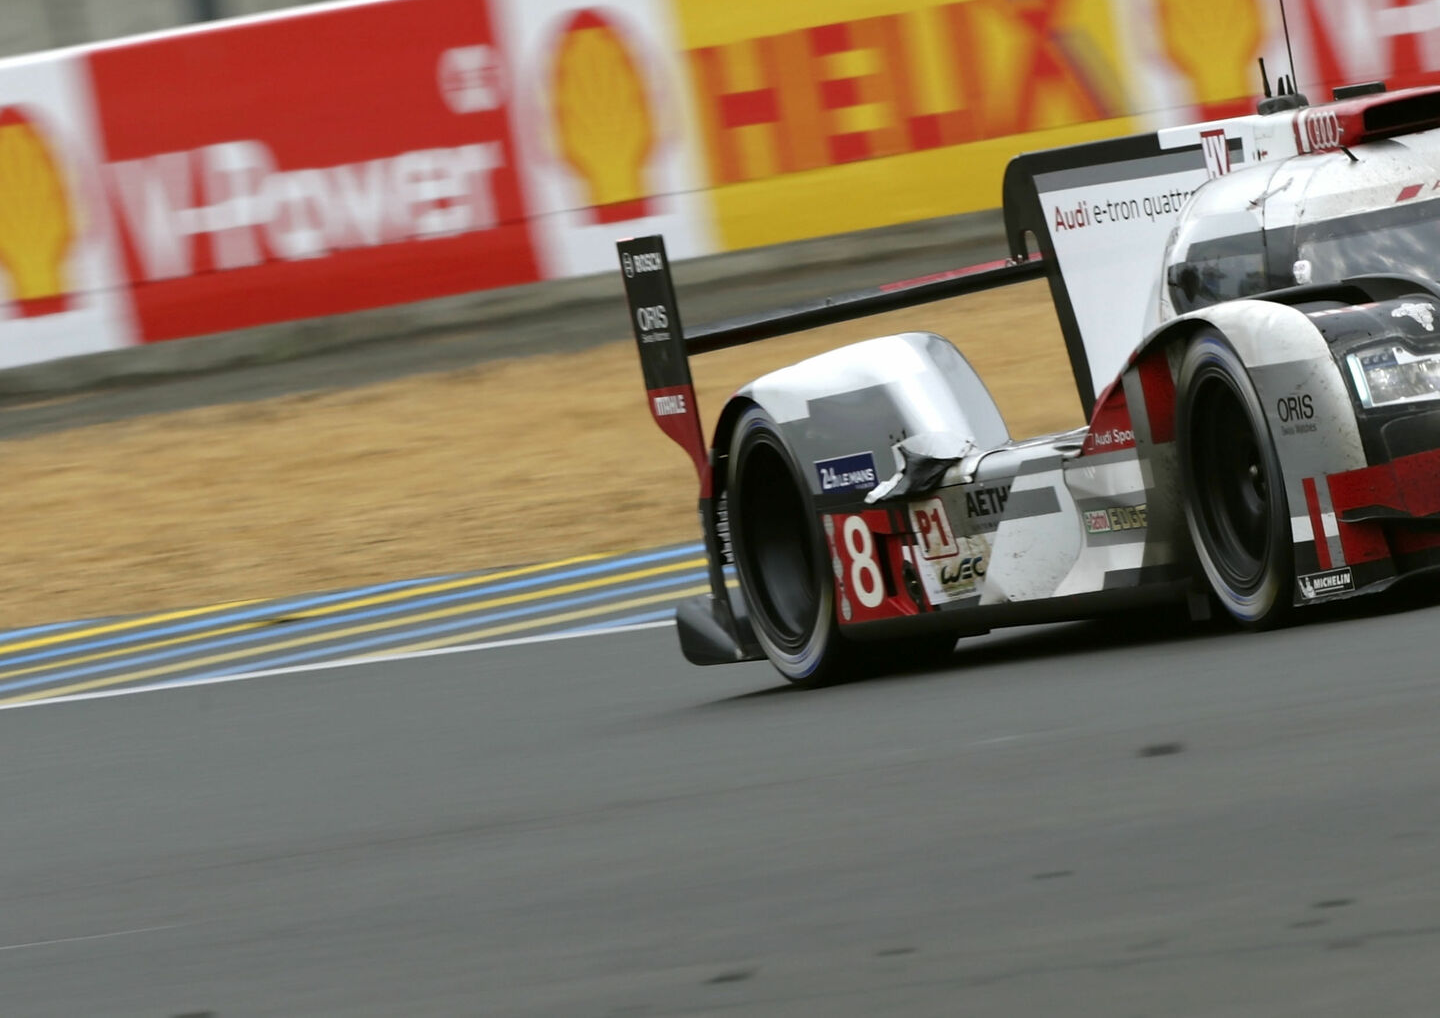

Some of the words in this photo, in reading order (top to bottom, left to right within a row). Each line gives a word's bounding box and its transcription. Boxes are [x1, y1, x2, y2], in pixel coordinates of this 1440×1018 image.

[104, 138, 504, 281] V-Power
[1055, 199, 1090, 232] Audi
[1093, 198, 1140, 224] e-tron
[1143, 189, 1195, 222] quattr
[633, 252, 664, 273] BOSCH
[1277, 394, 1314, 423] ORIS
[1095, 430, 1112, 445] Audi
[915, 508, 949, 552] P1
[1109, 504, 1148, 531] EDGE
[844, 515, 884, 608] 8
[941, 556, 986, 584] WEC
[1313, 573, 1351, 589] MICHELIN
